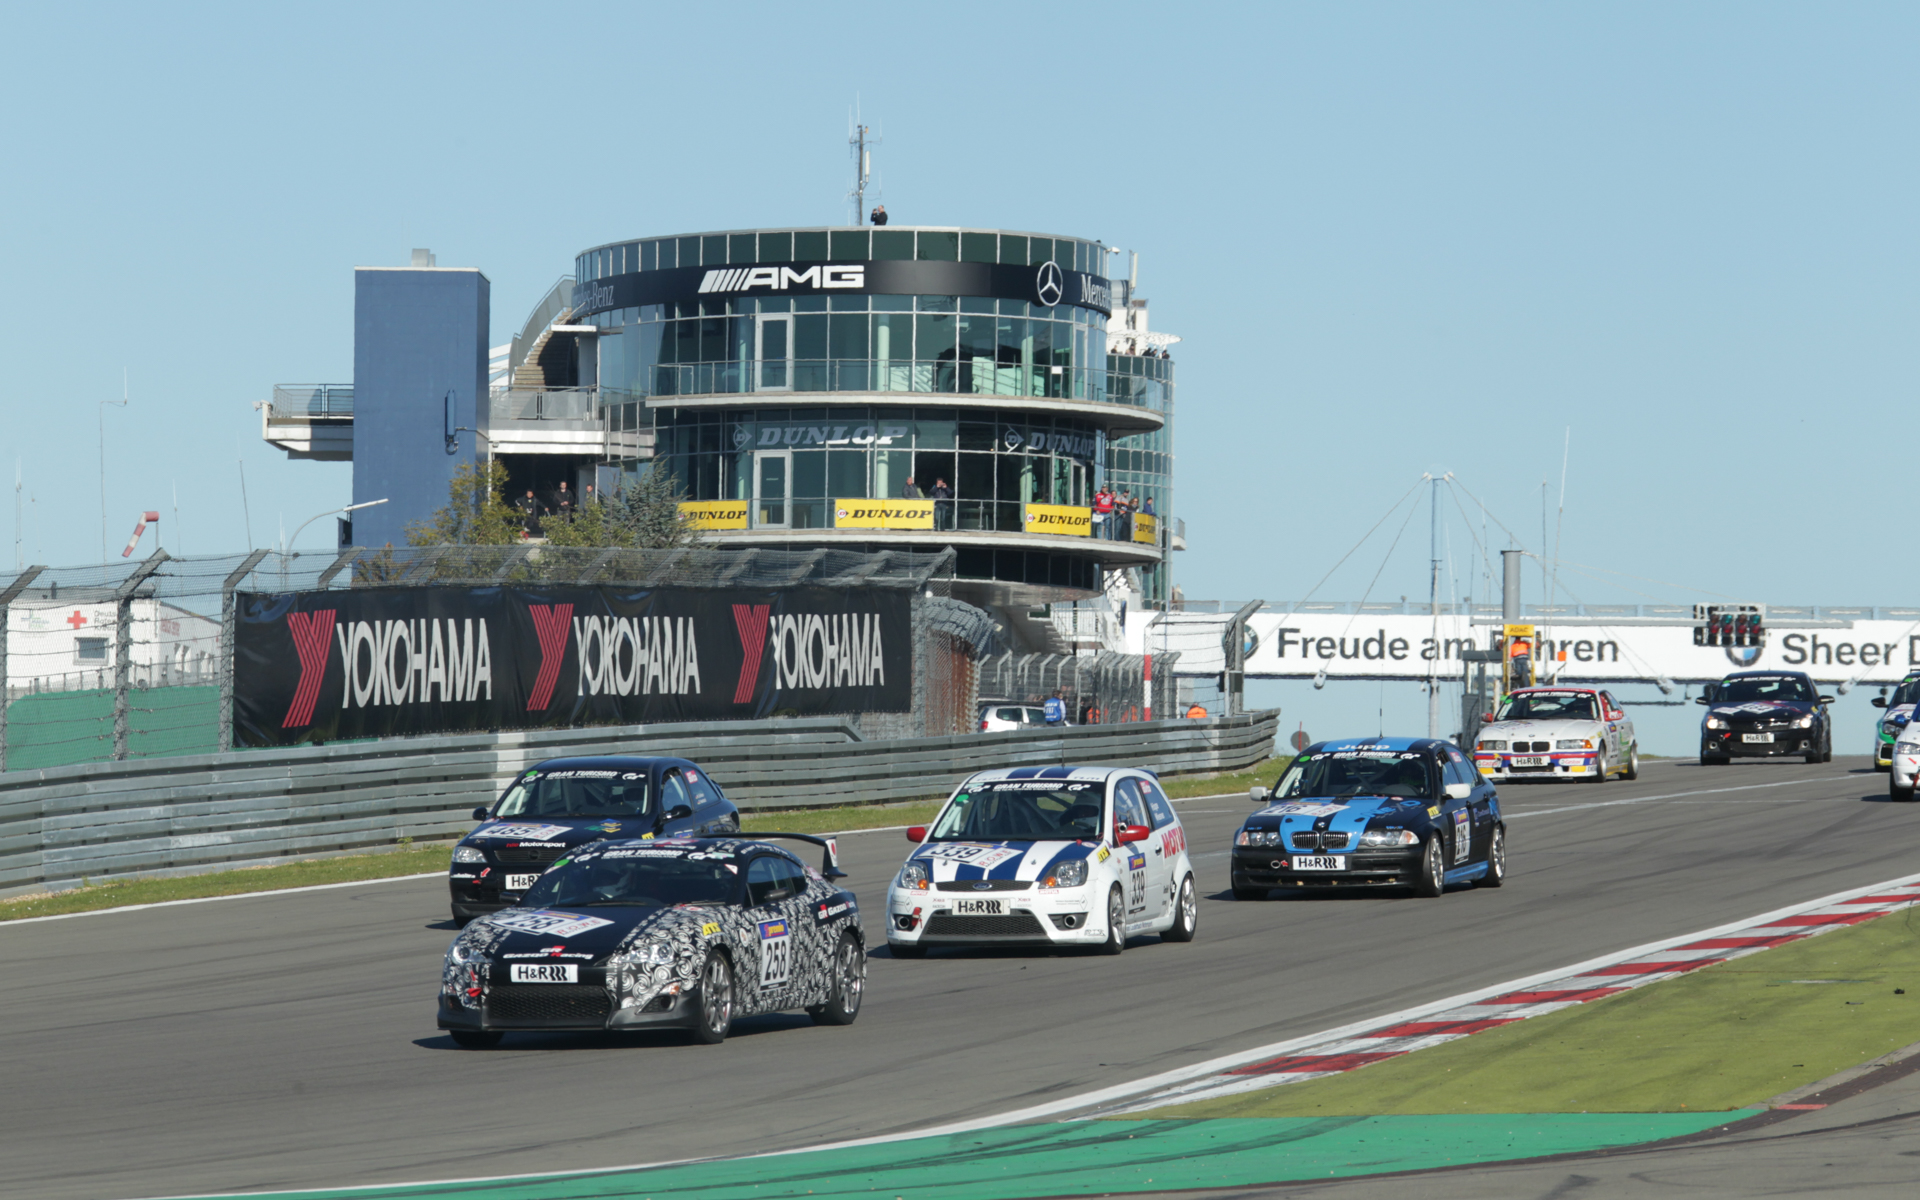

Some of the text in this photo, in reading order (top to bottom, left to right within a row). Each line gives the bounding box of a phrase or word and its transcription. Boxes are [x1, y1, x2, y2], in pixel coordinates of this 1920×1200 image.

[741, 264, 865, 289] AMG
[757, 426, 908, 446] DUNLOP
[1030, 432, 1095, 456] DUNLOP
[688, 509, 747, 520] DUNLOP
[851, 509, 933, 519] DUNLOP
[1037, 514, 1090, 526] DUNLOP
[573, 615, 701, 696] YOKOHAMA
[770, 613, 885, 690] YOKOHAMA
[1278, 628, 1409, 660] Freude
[1421, 637, 1476, 661] am
[1782, 633, 1898, 666] Sheer
[336, 618, 492, 709] YOKOHAMA
[603, 849, 635, 857] GRAN
[931, 845, 983, 859] 339
[1161, 826, 1186, 859] MOTU
[1298, 856, 1322, 868] H&R
[1131, 870, 1145, 906] 339
[958, 901, 985, 912] H&R
[502, 915, 565, 930] 258
[765, 940, 787, 981] 258
[518, 966, 548, 980] H&R
